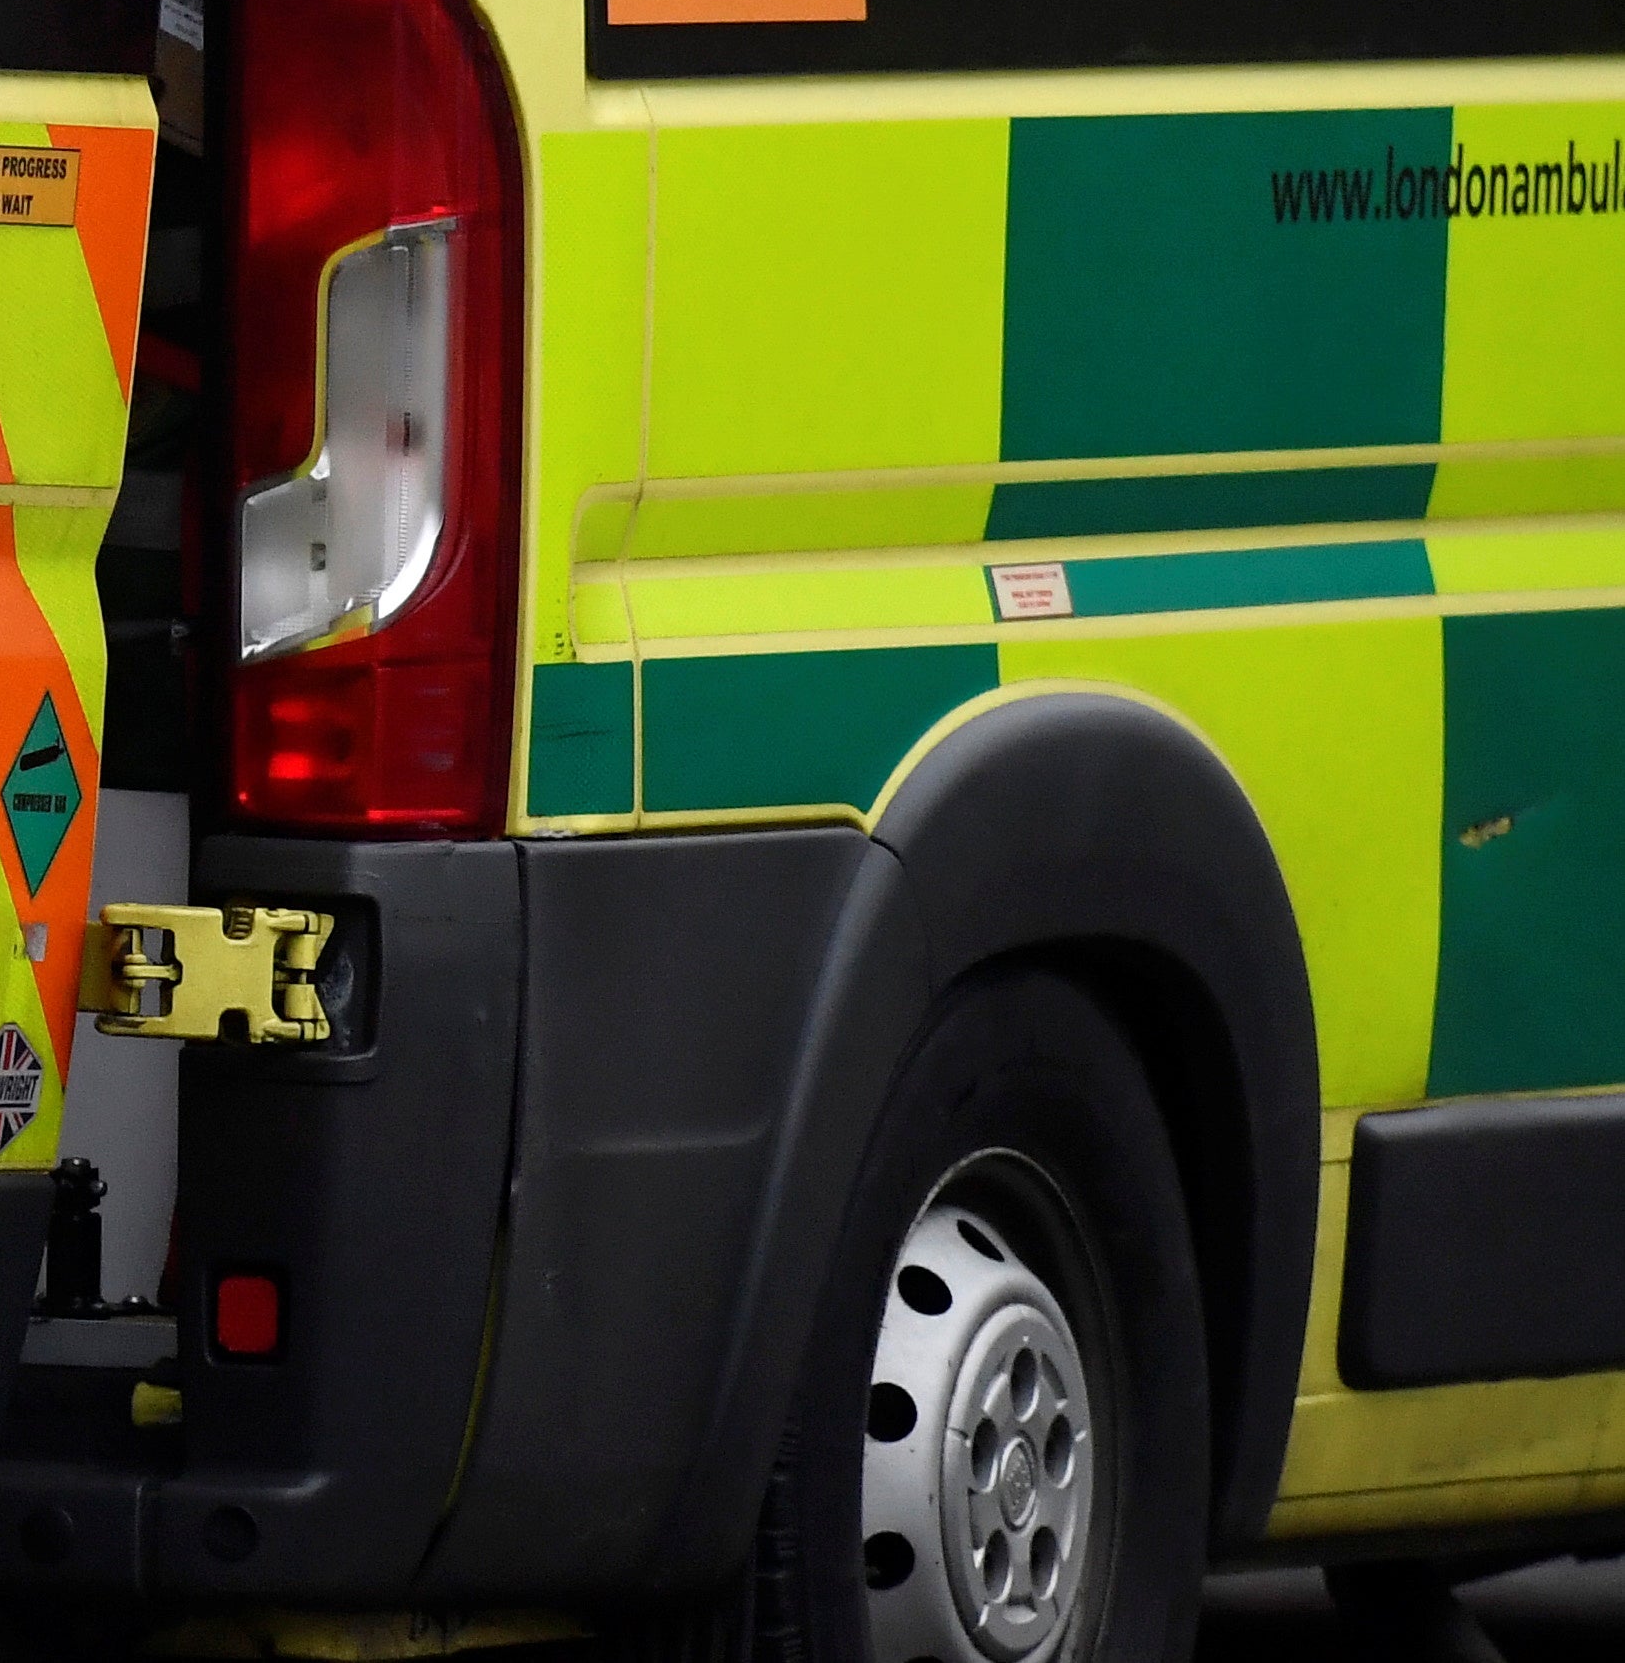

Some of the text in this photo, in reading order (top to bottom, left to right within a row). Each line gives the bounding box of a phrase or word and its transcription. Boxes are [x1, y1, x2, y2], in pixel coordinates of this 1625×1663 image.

[1, 156, 67, 180] PROGRESS
[1270, 139, 1625, 224] www.londonambul
[1, 194, 34, 216] WAIT
